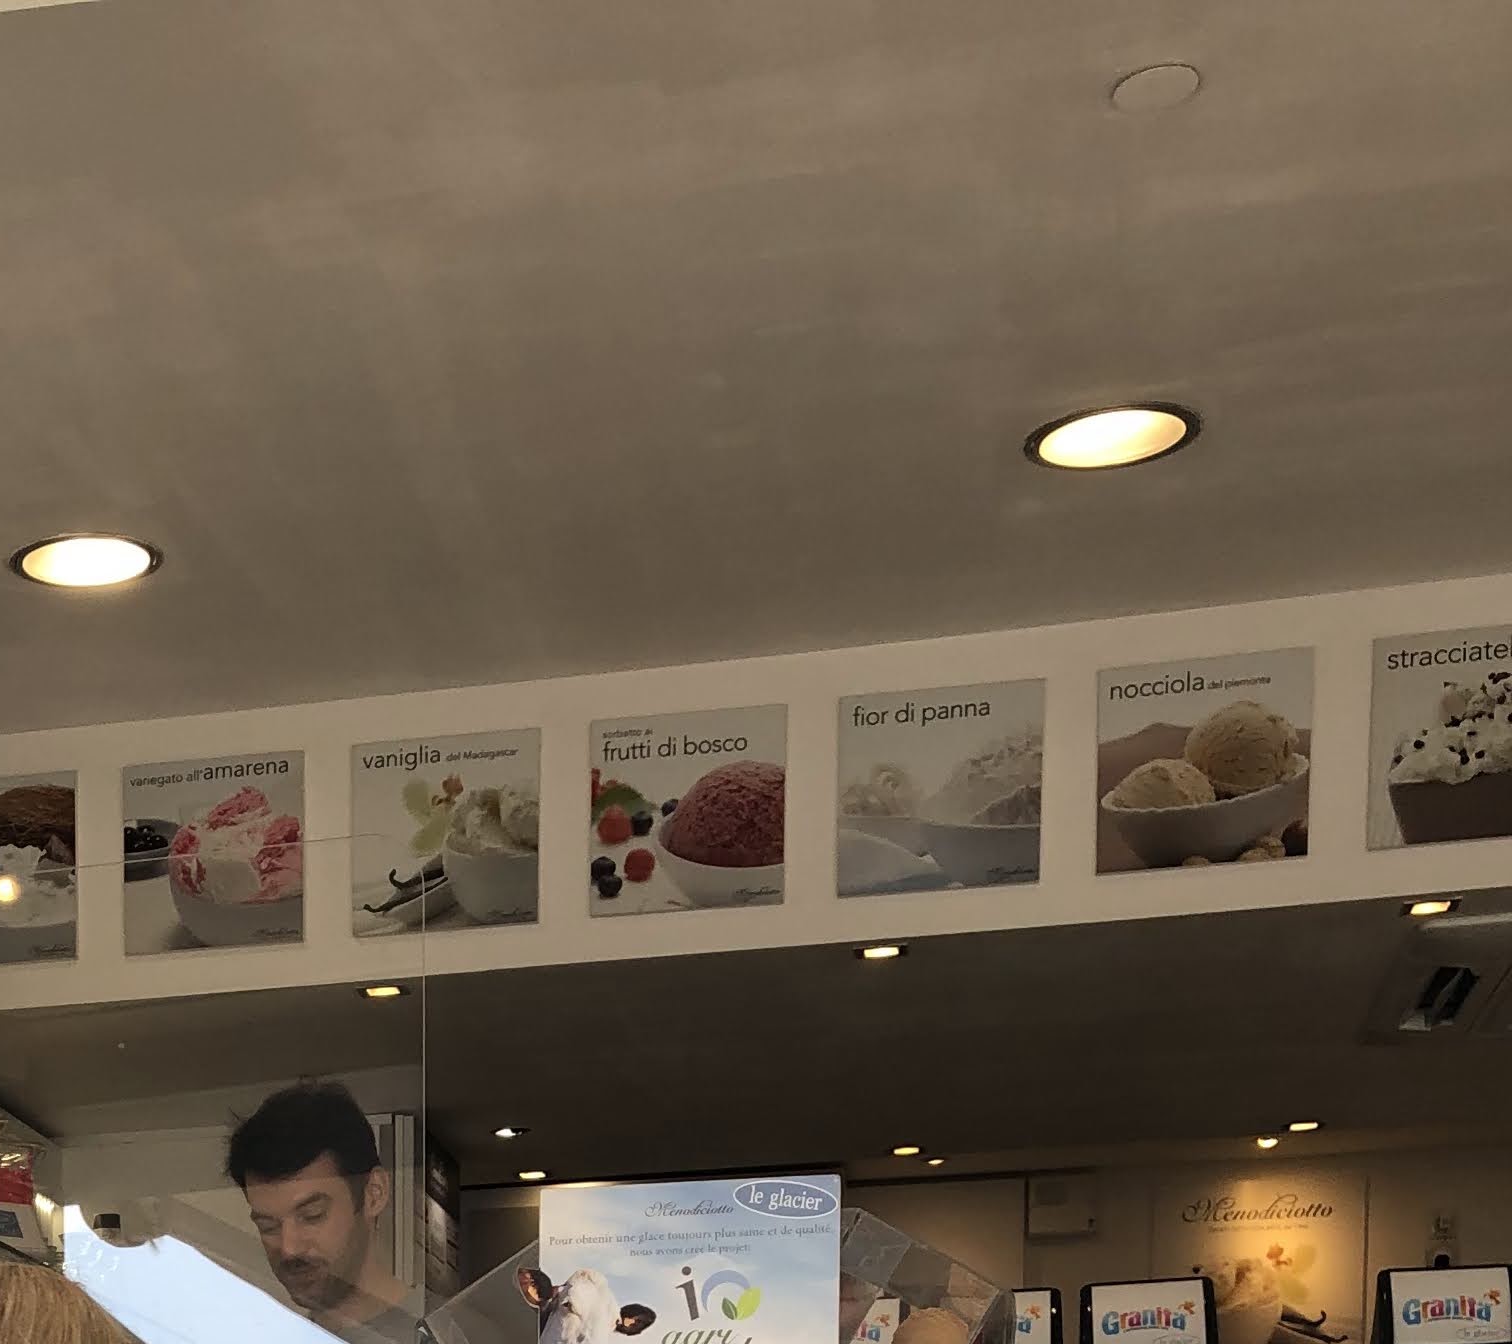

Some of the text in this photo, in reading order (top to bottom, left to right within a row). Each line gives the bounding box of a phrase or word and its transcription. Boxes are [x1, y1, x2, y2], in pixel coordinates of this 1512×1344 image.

[1109, 670, 1272, 700] nocciola del piemonte
[852, 697, 991, 727] fior di panna
[362, 745, 442, 772] vaniglia
[462, 746, 520, 762] Madagascar
[602, 734, 749, 763] frutti di bosco
[129, 772, 184, 790] variegato
[644, 1199, 736, 1218] Menodiciotto
[749, 1184, 823, 1212] le glacier
[1182, 1193, 1334, 1226] Menodiciotto
[549, 1235, 574, 1247] Pour
[575, 1233, 613, 1246] obtenir
[616, 1233, 637, 1243] une
[639, 1231, 665, 1245] glace
[667, 1230, 712, 1244] toujours
[714, 1228, 737, 1242] plus
[739, 1226, 765, 1237] saine
[767, 1226, 778, 1236] et
[779, 1224, 793, 1235] de
[1101, 1307, 1187, 1336] Granita
[1401, 1294, 1493, 1327] Granita
